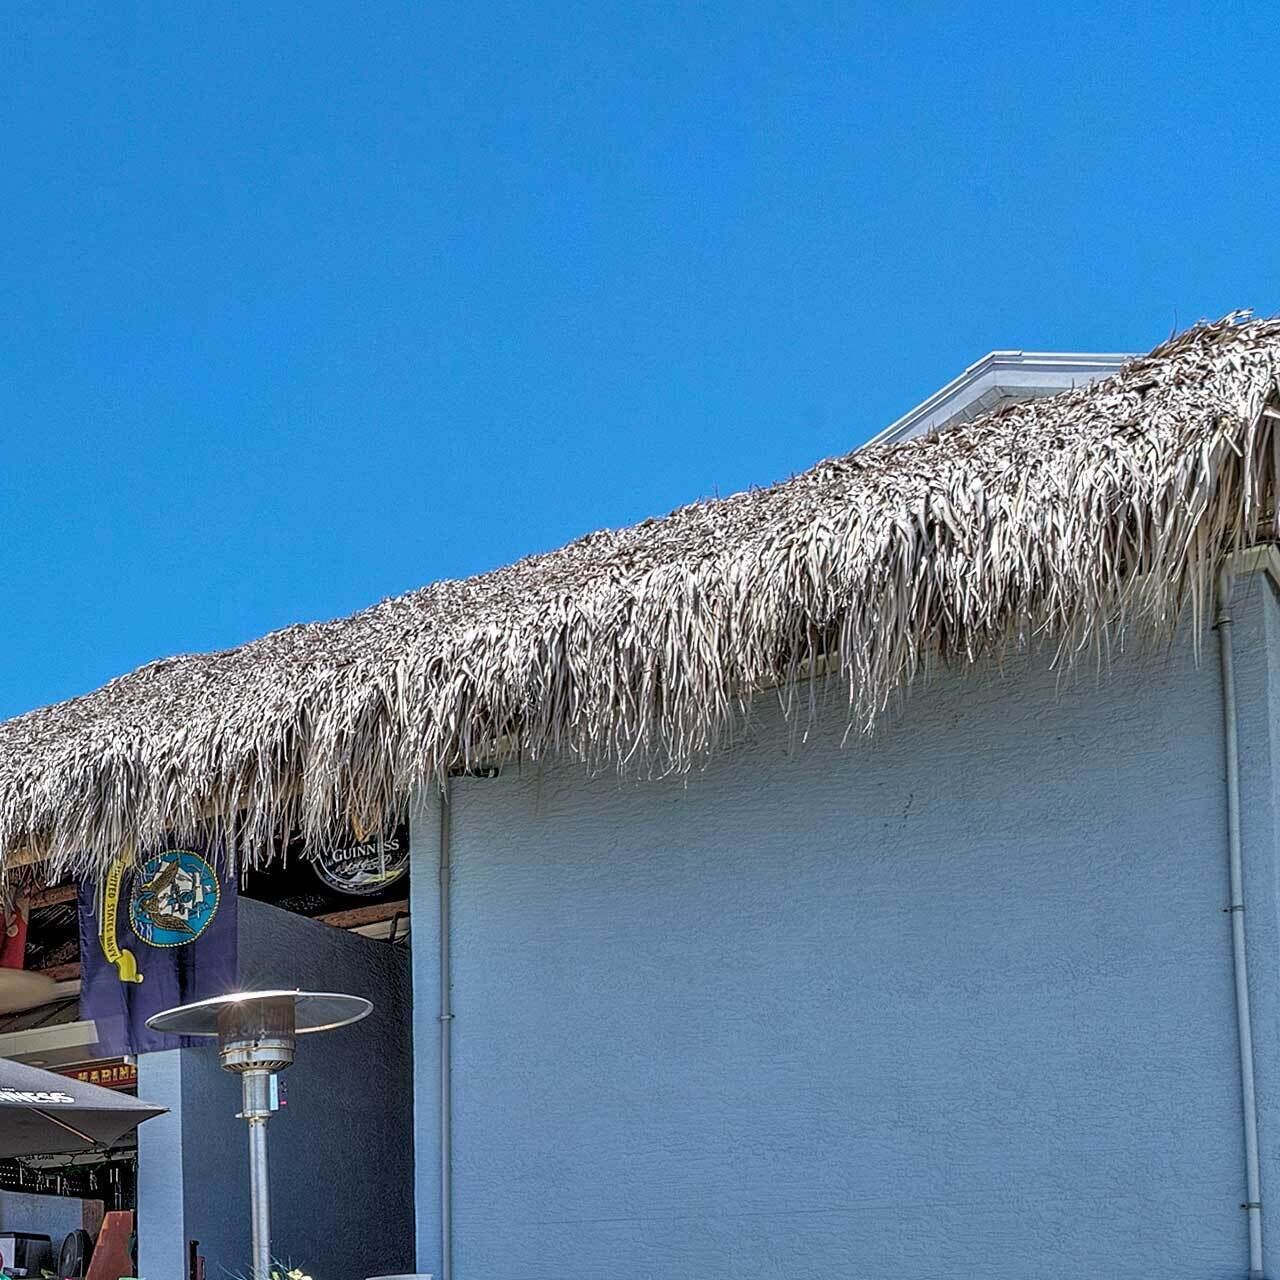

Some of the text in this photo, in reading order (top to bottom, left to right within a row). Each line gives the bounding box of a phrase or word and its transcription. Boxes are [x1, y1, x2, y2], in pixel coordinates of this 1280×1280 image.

[332, 838, 400, 862] GUINNSS
[106, 903, 115, 933] STATES
[106, 936, 118, 958] NAVY
